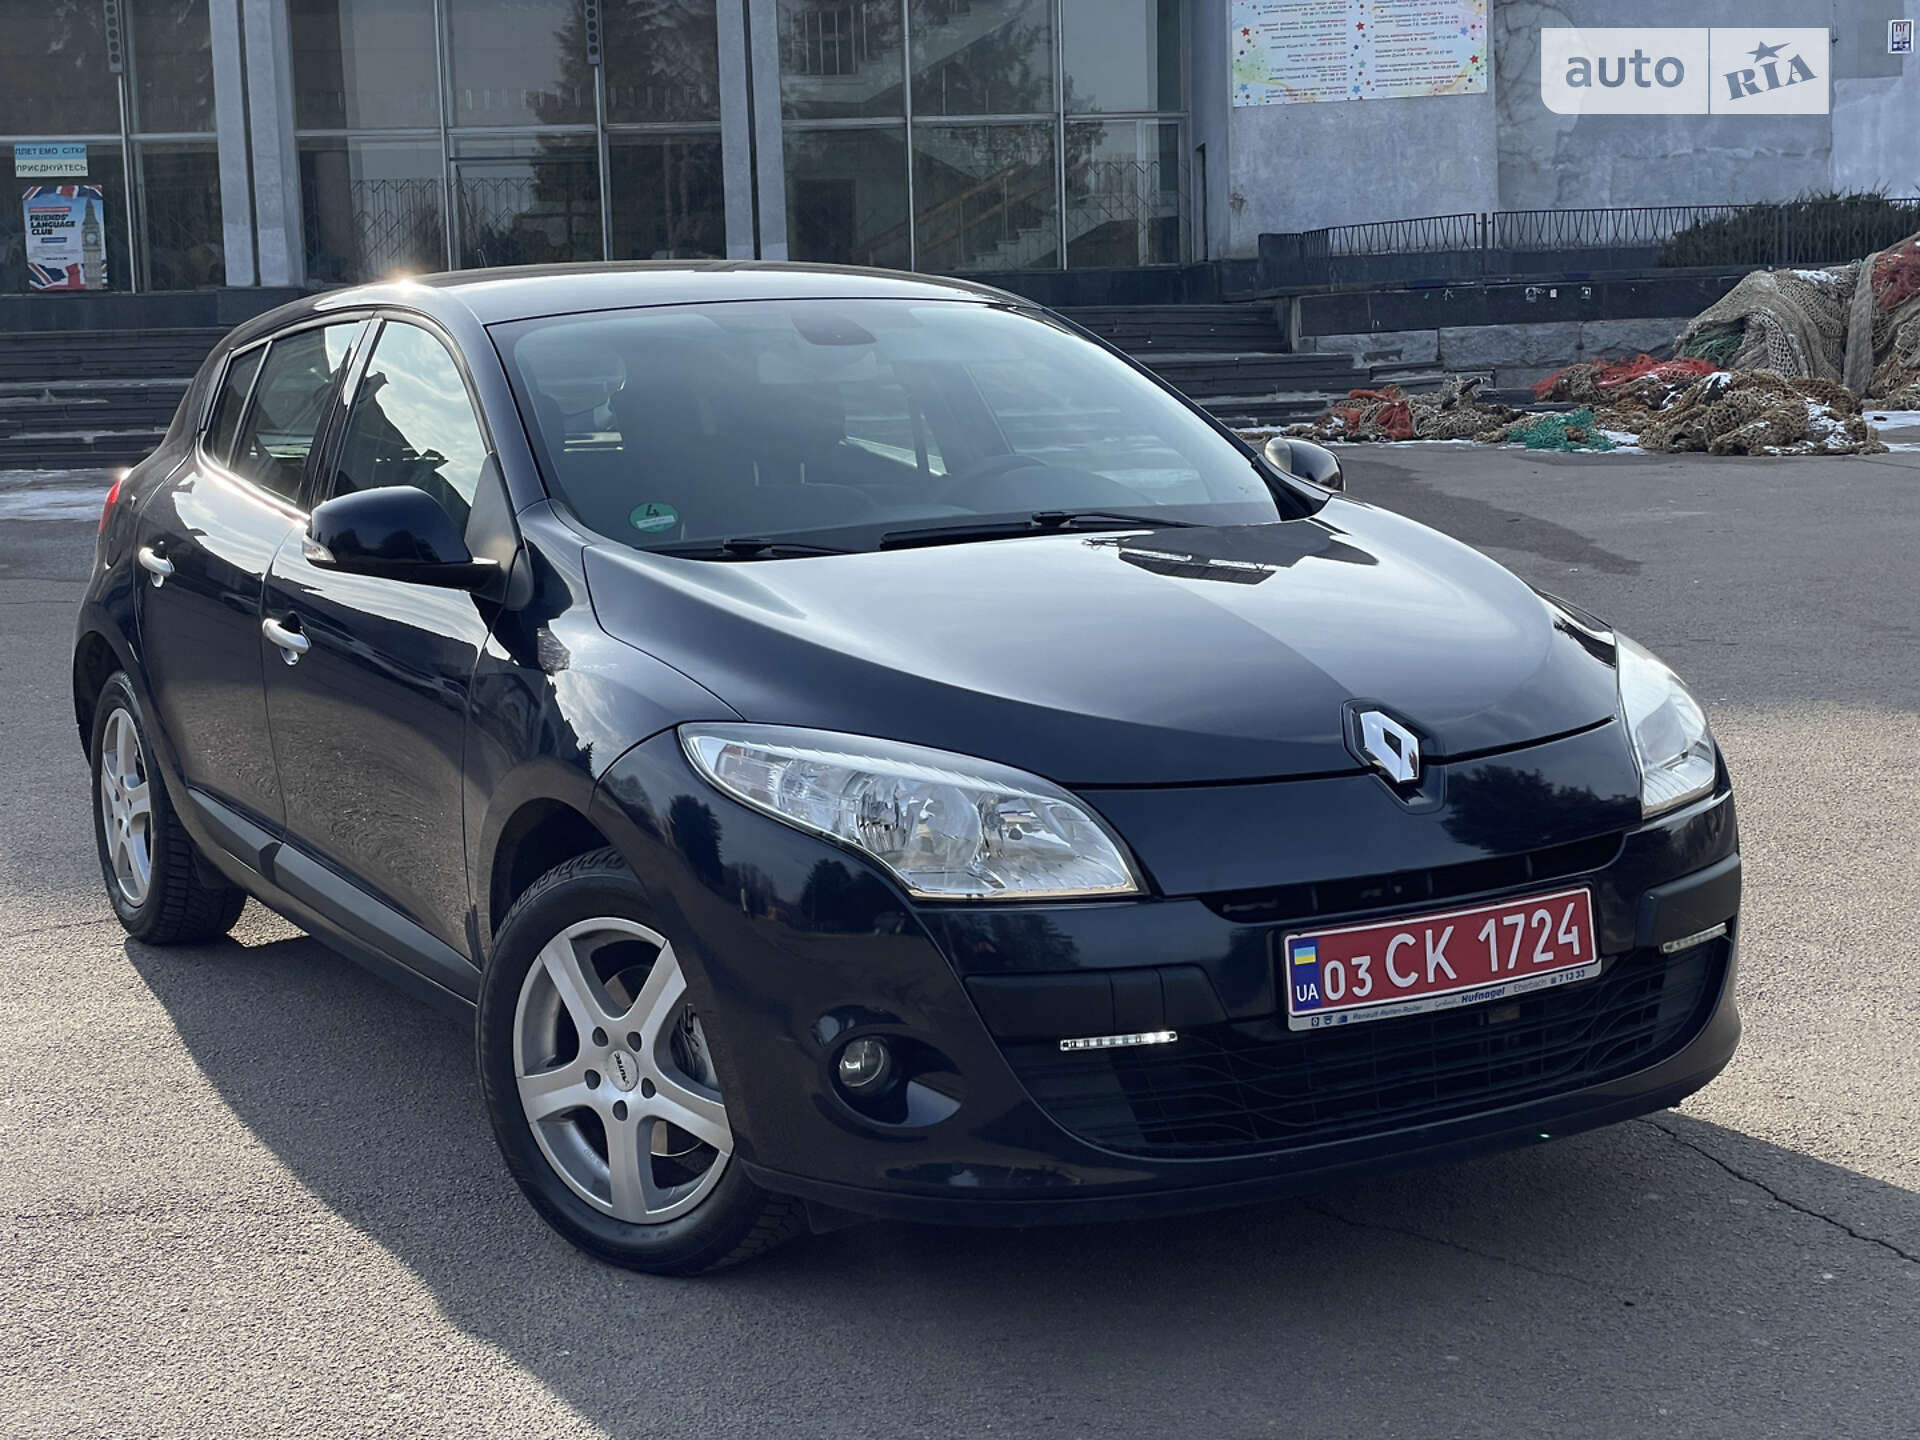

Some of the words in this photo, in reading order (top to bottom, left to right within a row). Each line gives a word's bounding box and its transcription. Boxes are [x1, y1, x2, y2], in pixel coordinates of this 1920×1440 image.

[30, 220, 76, 229] LANGUAGE
[31, 228, 54, 236] CLUB
[645, 503, 661, 517] 4
[1323, 955, 1373, 1001] 03
[1385, 925, 1457, 988] CK
[1477, 902, 1581, 973] 1724
[1295, 983, 1320, 1003] UA
[1460, 986, 1506, 1004] Hufnagel
